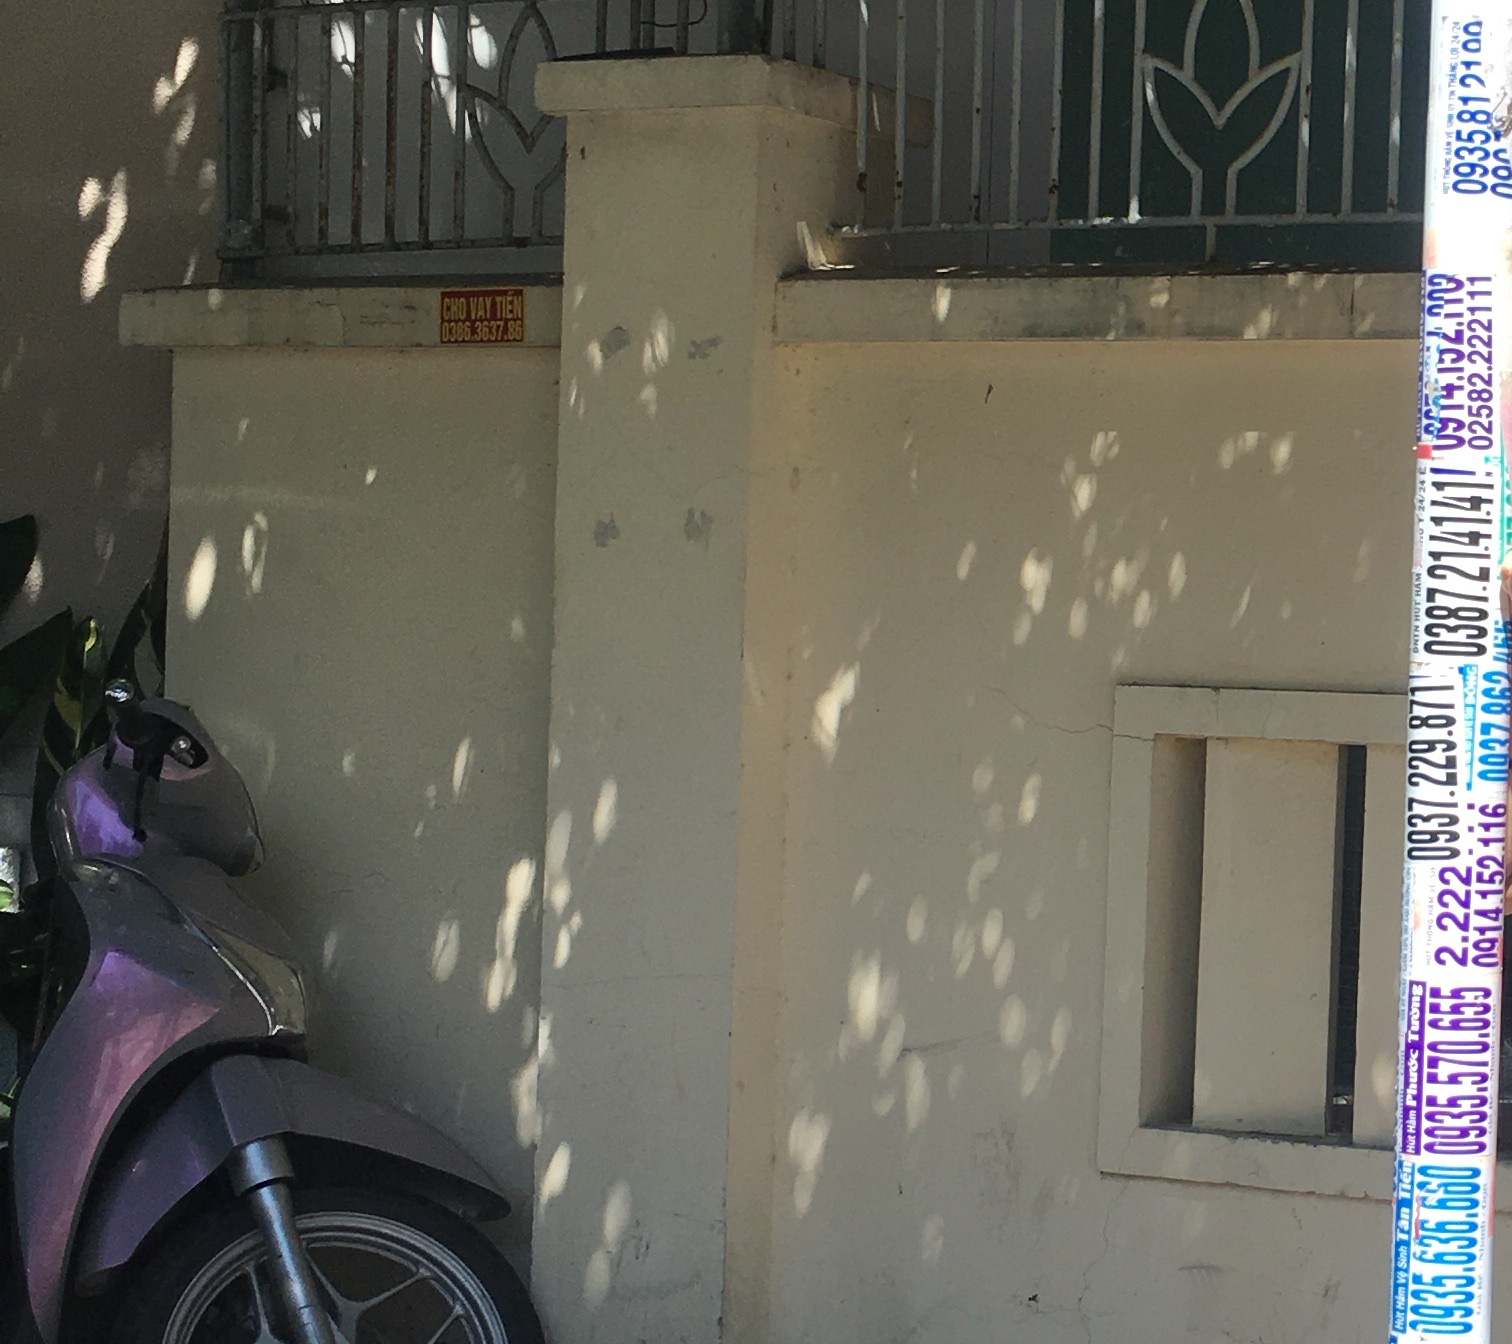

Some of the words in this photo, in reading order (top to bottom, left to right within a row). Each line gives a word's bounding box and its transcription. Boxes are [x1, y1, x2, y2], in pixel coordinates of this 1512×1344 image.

[443, 297, 467, 321] CHO
[470, 296, 493, 320] VAY
[1466, 275, 1494, 451] 02582.222111
[1422, 480, 1495, 658] 0387.21.41.41
[1406, 684, 1461, 862] 0937.229.871
[1471, 802, 1507, 968] 0914.152.116
[1407, 983, 1424, 1044] Tường
[1405, 1048, 1419, 1107] Phước
[1423, 986, 1492, 1156] 0935.570.655
[1395, 1207, 1411, 1243] Tân
[1396, 1245, 1409, 1270] Sinh
